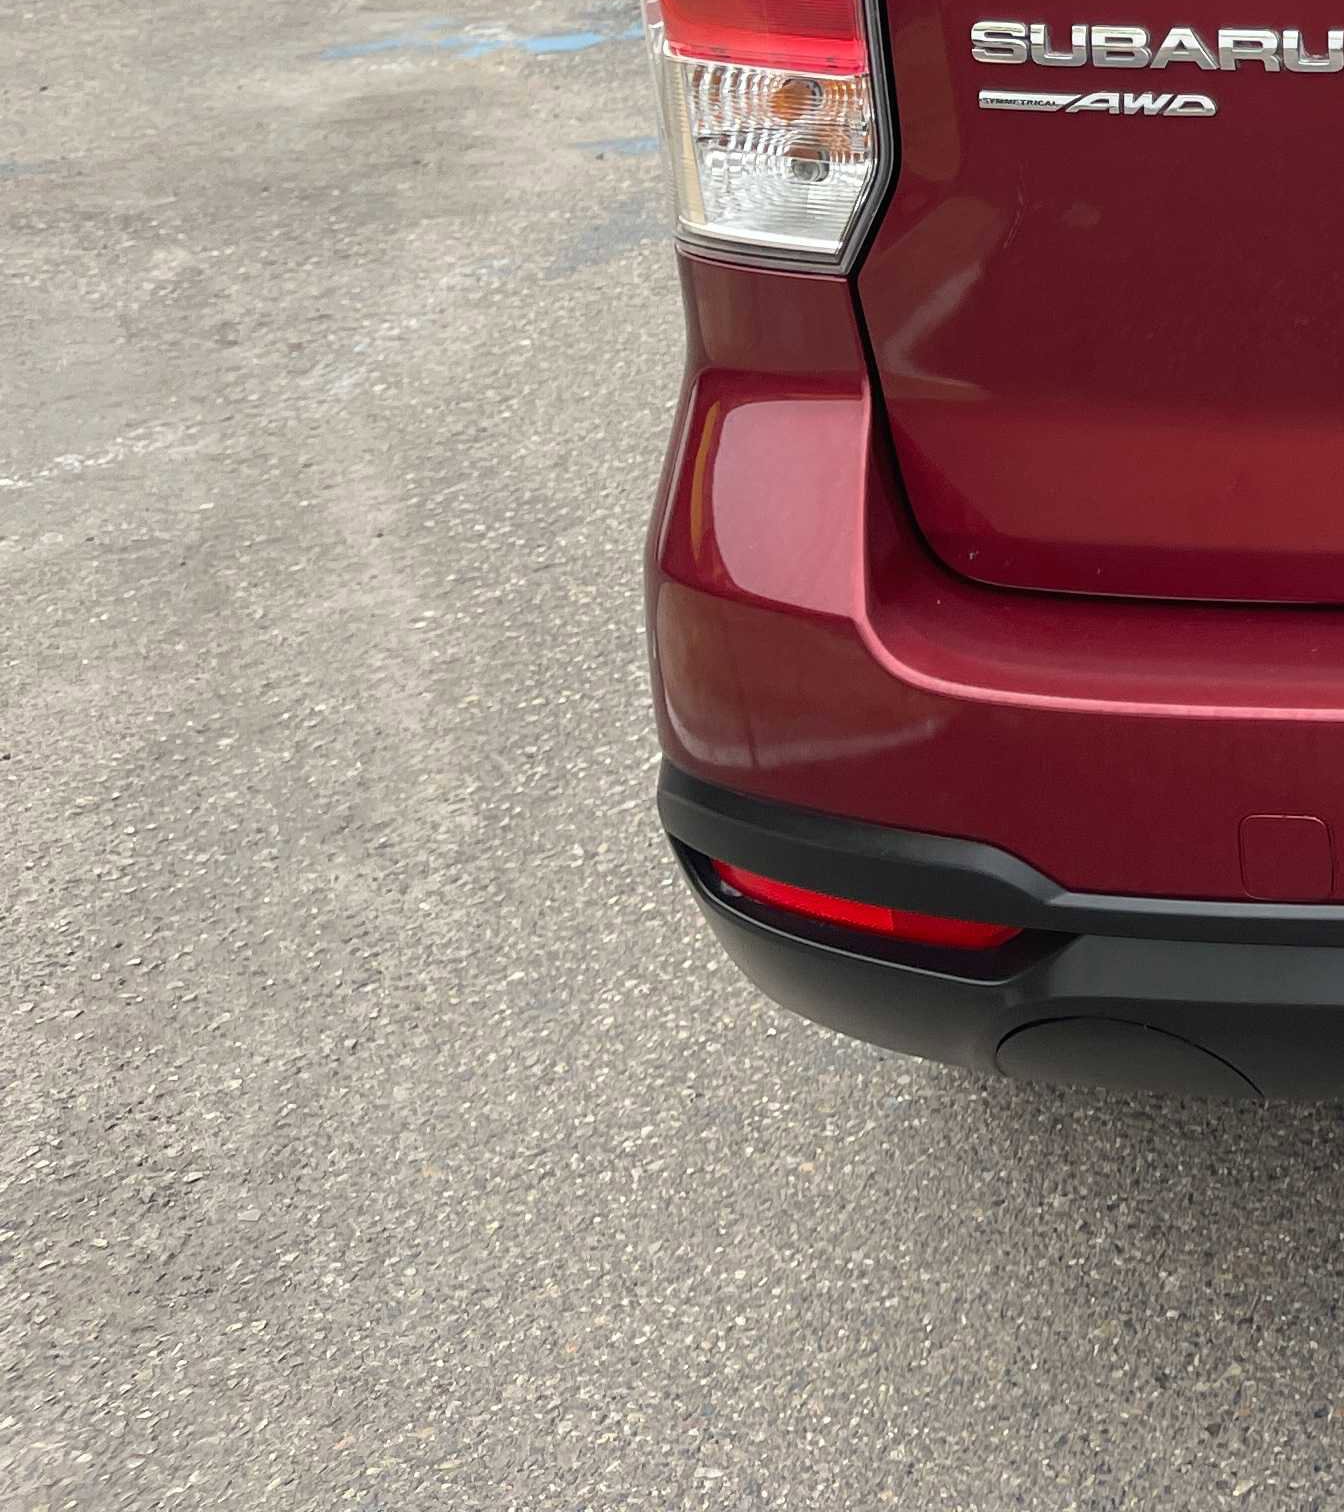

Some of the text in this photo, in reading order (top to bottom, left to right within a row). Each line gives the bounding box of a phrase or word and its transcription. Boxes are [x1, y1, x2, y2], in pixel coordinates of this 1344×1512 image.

[971, 21, 1344, 72] SUBARU
[982, 92, 1216, 116] SYMMETRICAL AWD
